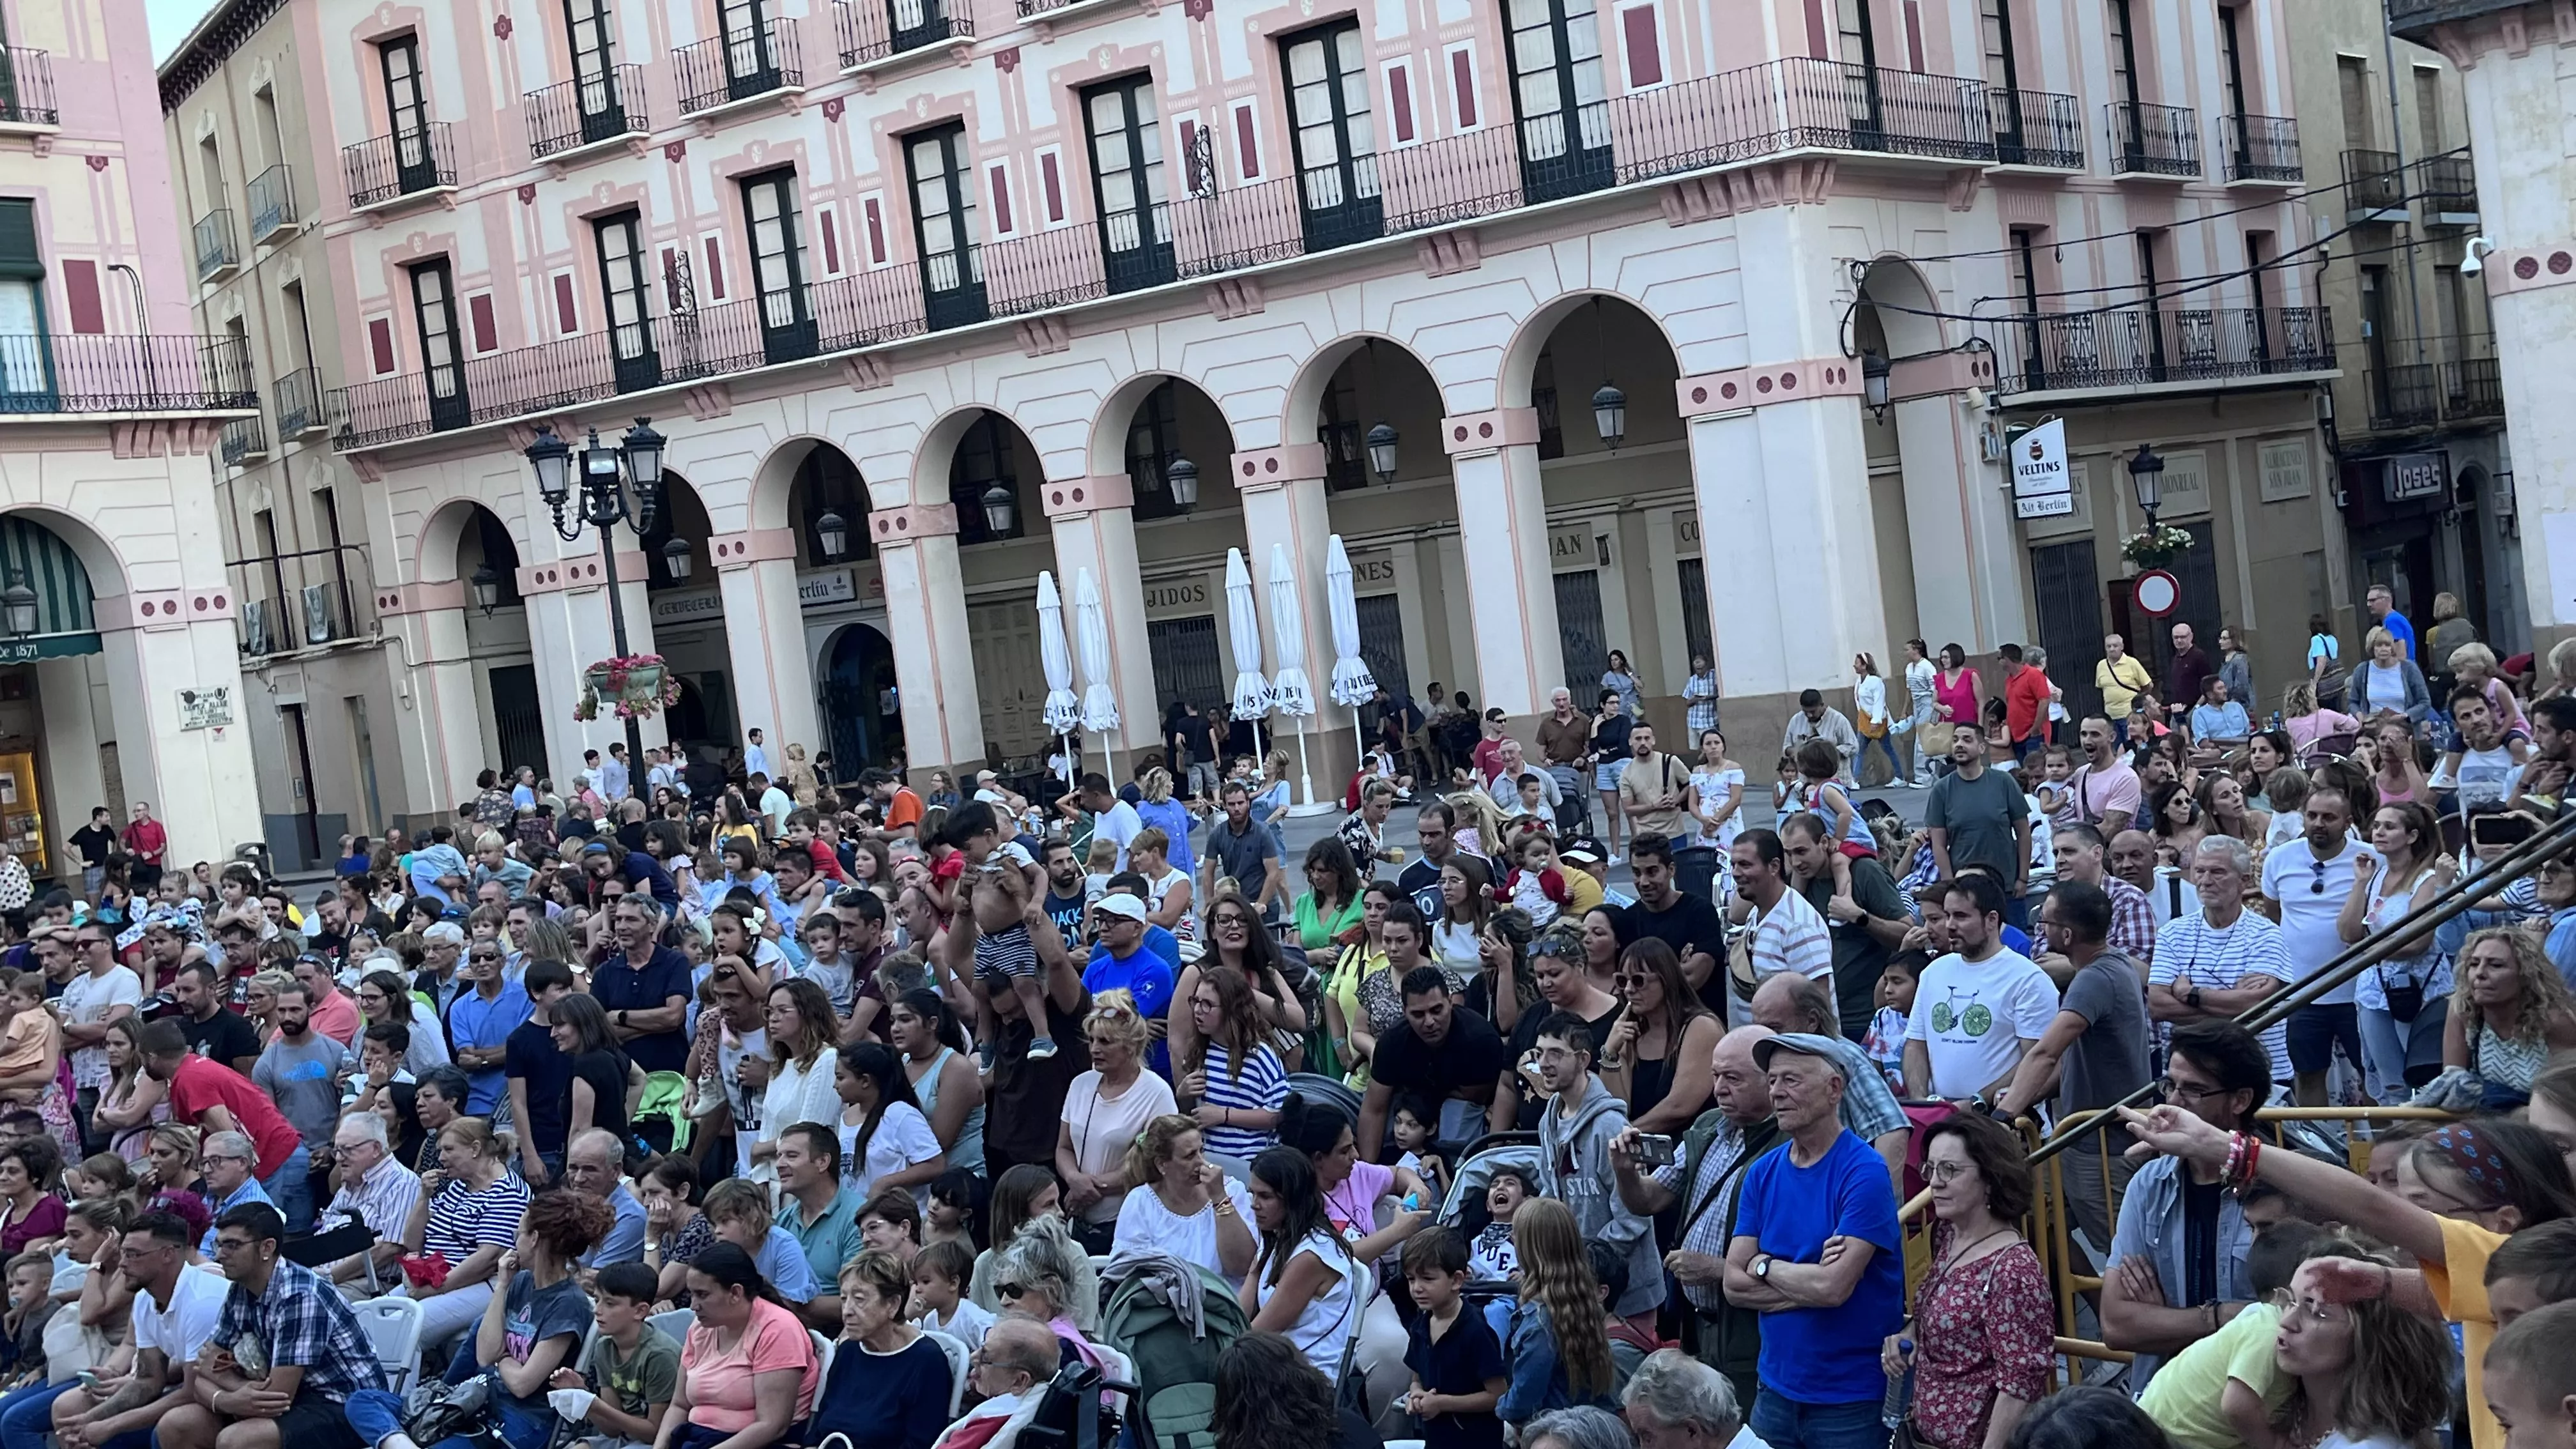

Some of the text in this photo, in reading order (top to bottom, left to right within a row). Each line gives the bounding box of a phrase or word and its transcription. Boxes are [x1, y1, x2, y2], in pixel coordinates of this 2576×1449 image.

[2019, 461, 2060, 476] VELTINS
[2037, 500, 2067, 511] Berlin
[1147, 585, 1205, 607] JIDOS
[16, 644, 38, 658] 1871
